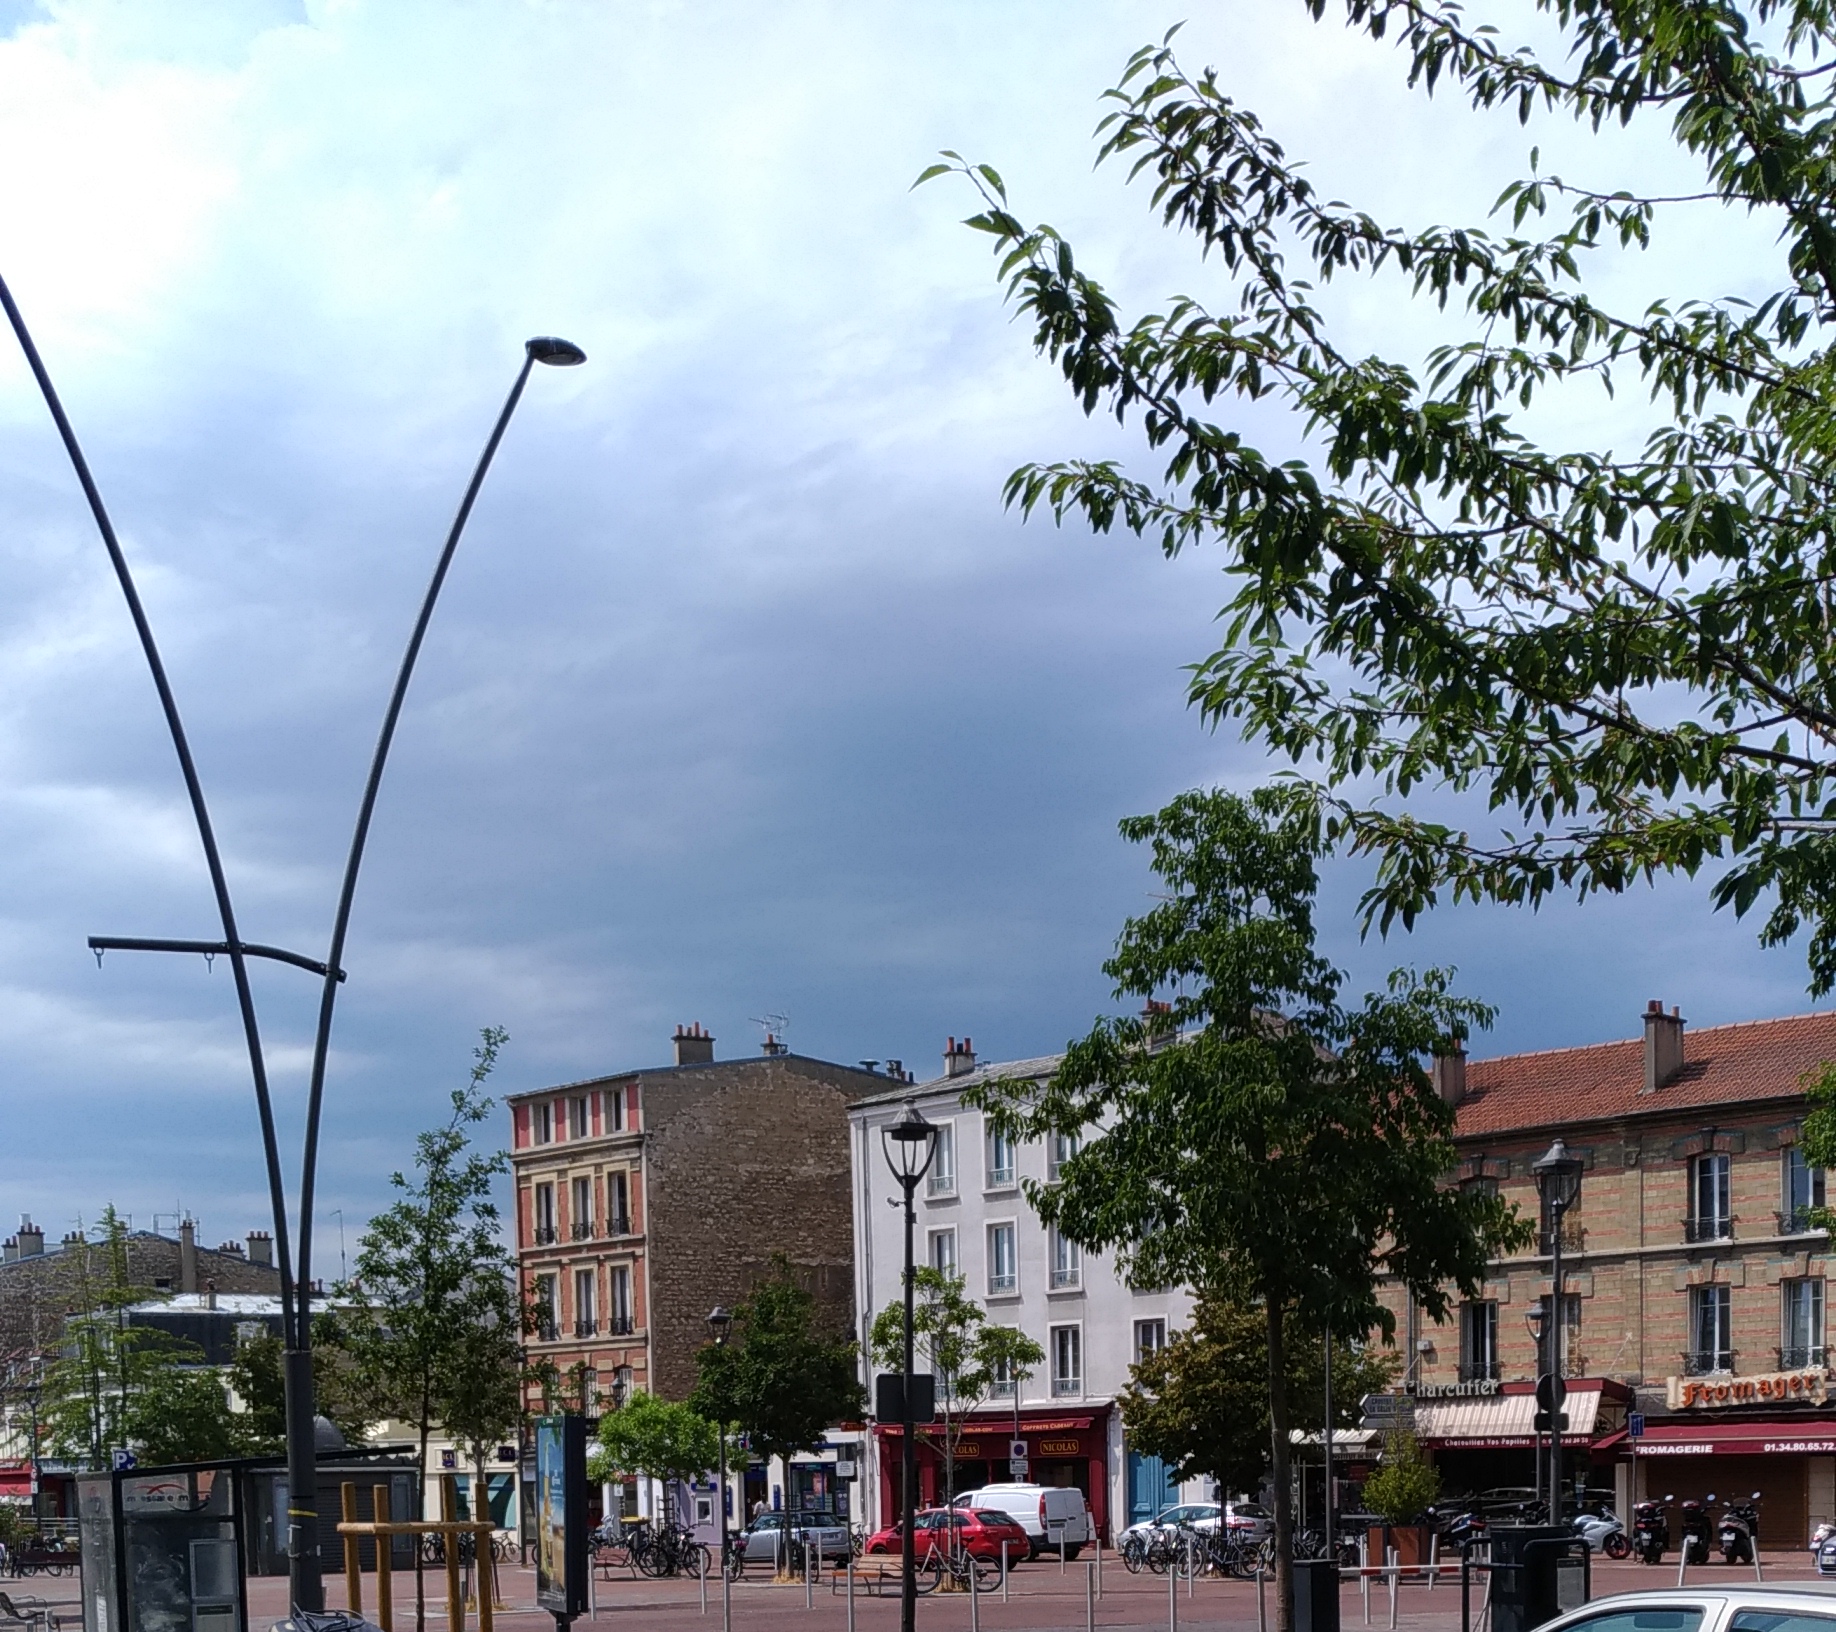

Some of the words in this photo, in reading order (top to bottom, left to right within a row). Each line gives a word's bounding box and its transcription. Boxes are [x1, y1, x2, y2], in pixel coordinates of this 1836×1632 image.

[1404, 1379, 1500, 1397] Charcutier
[1681, 1373, 1818, 1407] Fromager
[1042, 1442, 1077, 1452] NICOLAS
[1501, 1437, 1530, 1446] Papilles
[115, 1452, 127, 1468] P
